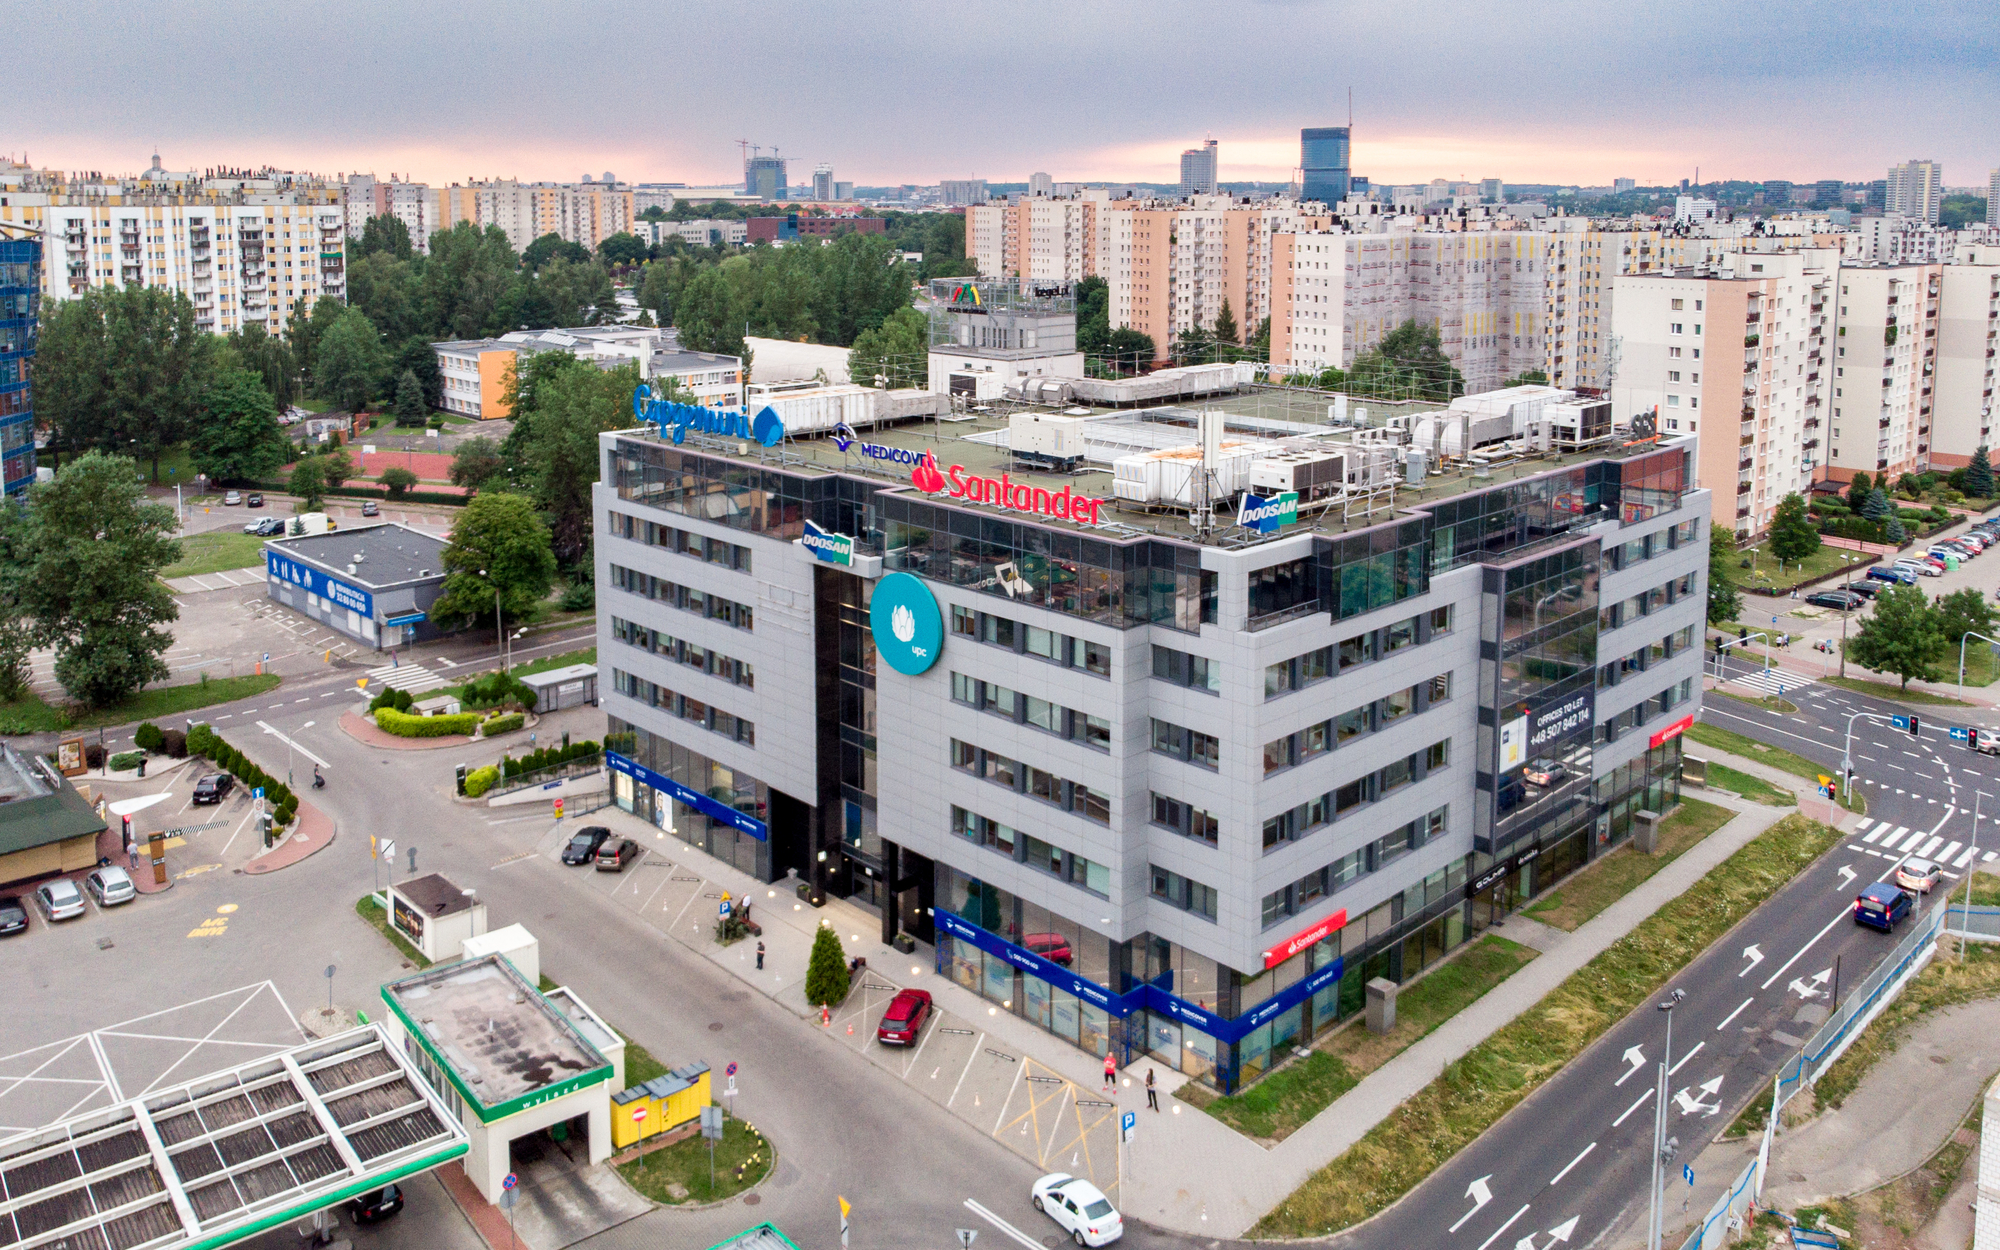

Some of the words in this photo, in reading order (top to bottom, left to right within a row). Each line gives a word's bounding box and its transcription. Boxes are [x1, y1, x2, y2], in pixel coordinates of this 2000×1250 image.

[633, 384, 750, 445] Capgemini
[949, 464, 1104, 525] Santander
[1242, 500, 1297, 524] DOOSAN
[803, 533, 850, 555] DOOSAN
[912, 645, 927, 658] upc
[1537, 706, 1563, 727] OFFICES
[1563, 704, 1573, 714] TO
[1572, 697, 1585, 709] LET
[1530, 729, 1546, 745] +48
[1546, 721, 1562, 739] 507
[1562, 714, 1578, 731] 842
[1577, 707, 1590, 723] 114
[722, 902, 729, 913] P
[1296, 926, 1328, 949] Santander
[1125, 1114, 1133, 1128] P
